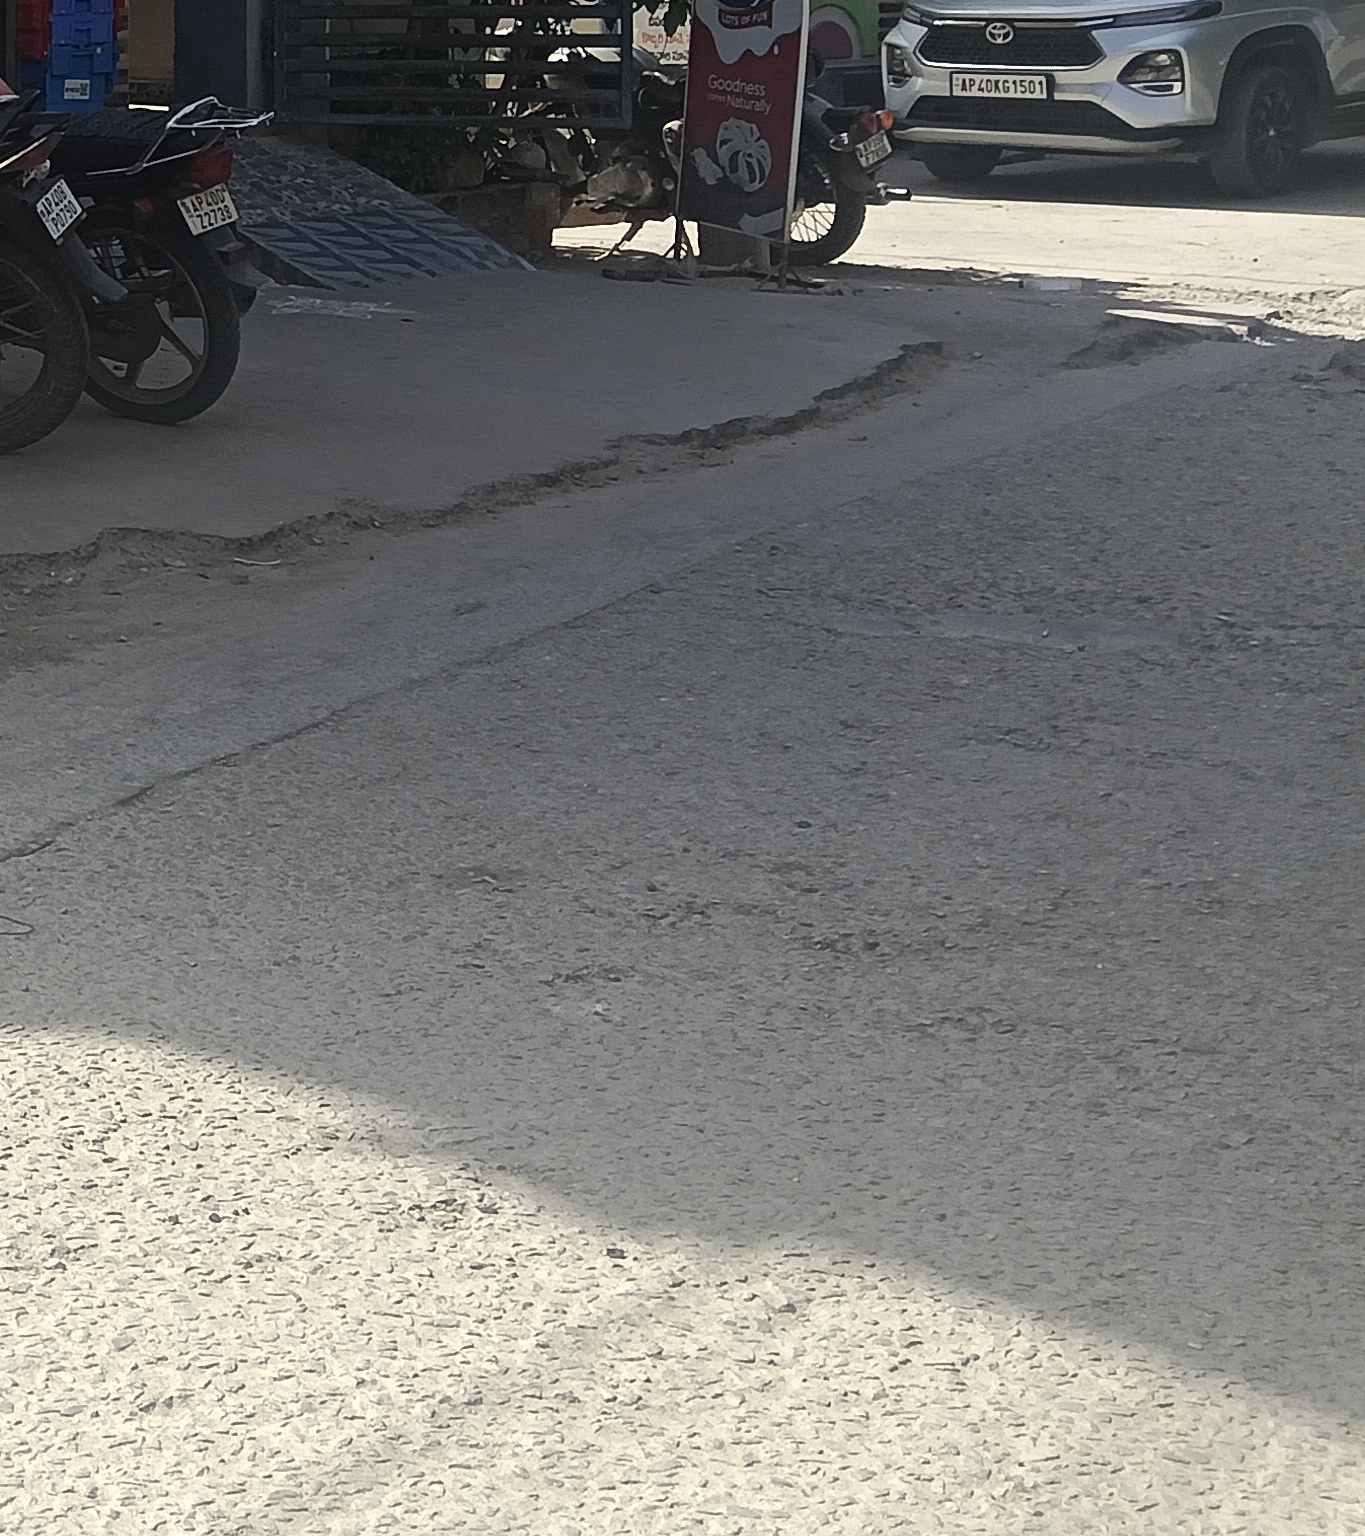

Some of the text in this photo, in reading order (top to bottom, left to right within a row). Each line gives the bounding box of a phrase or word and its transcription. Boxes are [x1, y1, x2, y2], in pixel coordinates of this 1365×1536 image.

[721, 11, 767, 25] LOTS OF FUN
[708, 74, 766, 96] Goodness
[726, 94, 771, 114] Naturally
